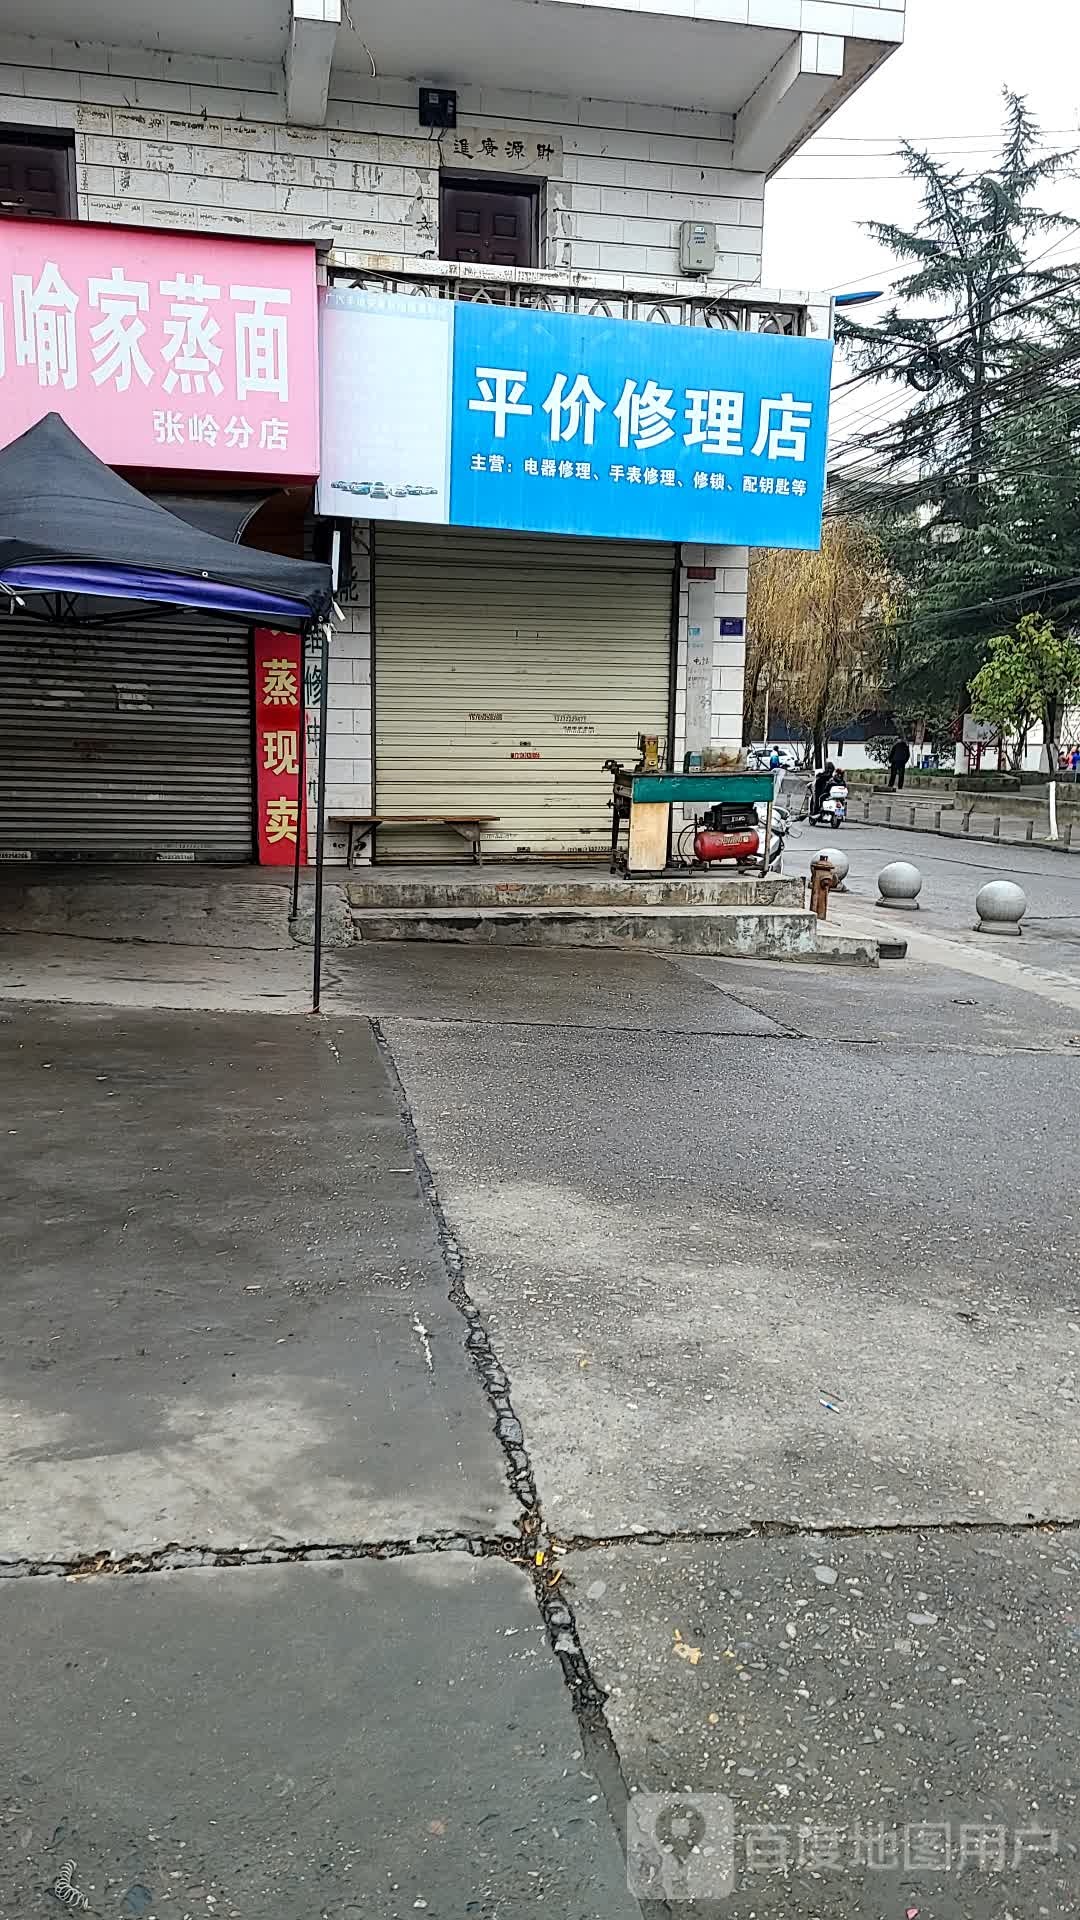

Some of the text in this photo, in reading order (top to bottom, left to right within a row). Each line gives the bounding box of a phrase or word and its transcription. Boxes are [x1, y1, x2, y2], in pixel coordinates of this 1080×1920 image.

[0, 261, 291, 402] 喻家蒸面
[152, 410, 289, 449] 张岭分店
[467, 367, 813, 462] 平价修理店
[262, 628, 299, 844] 蒸现卖
